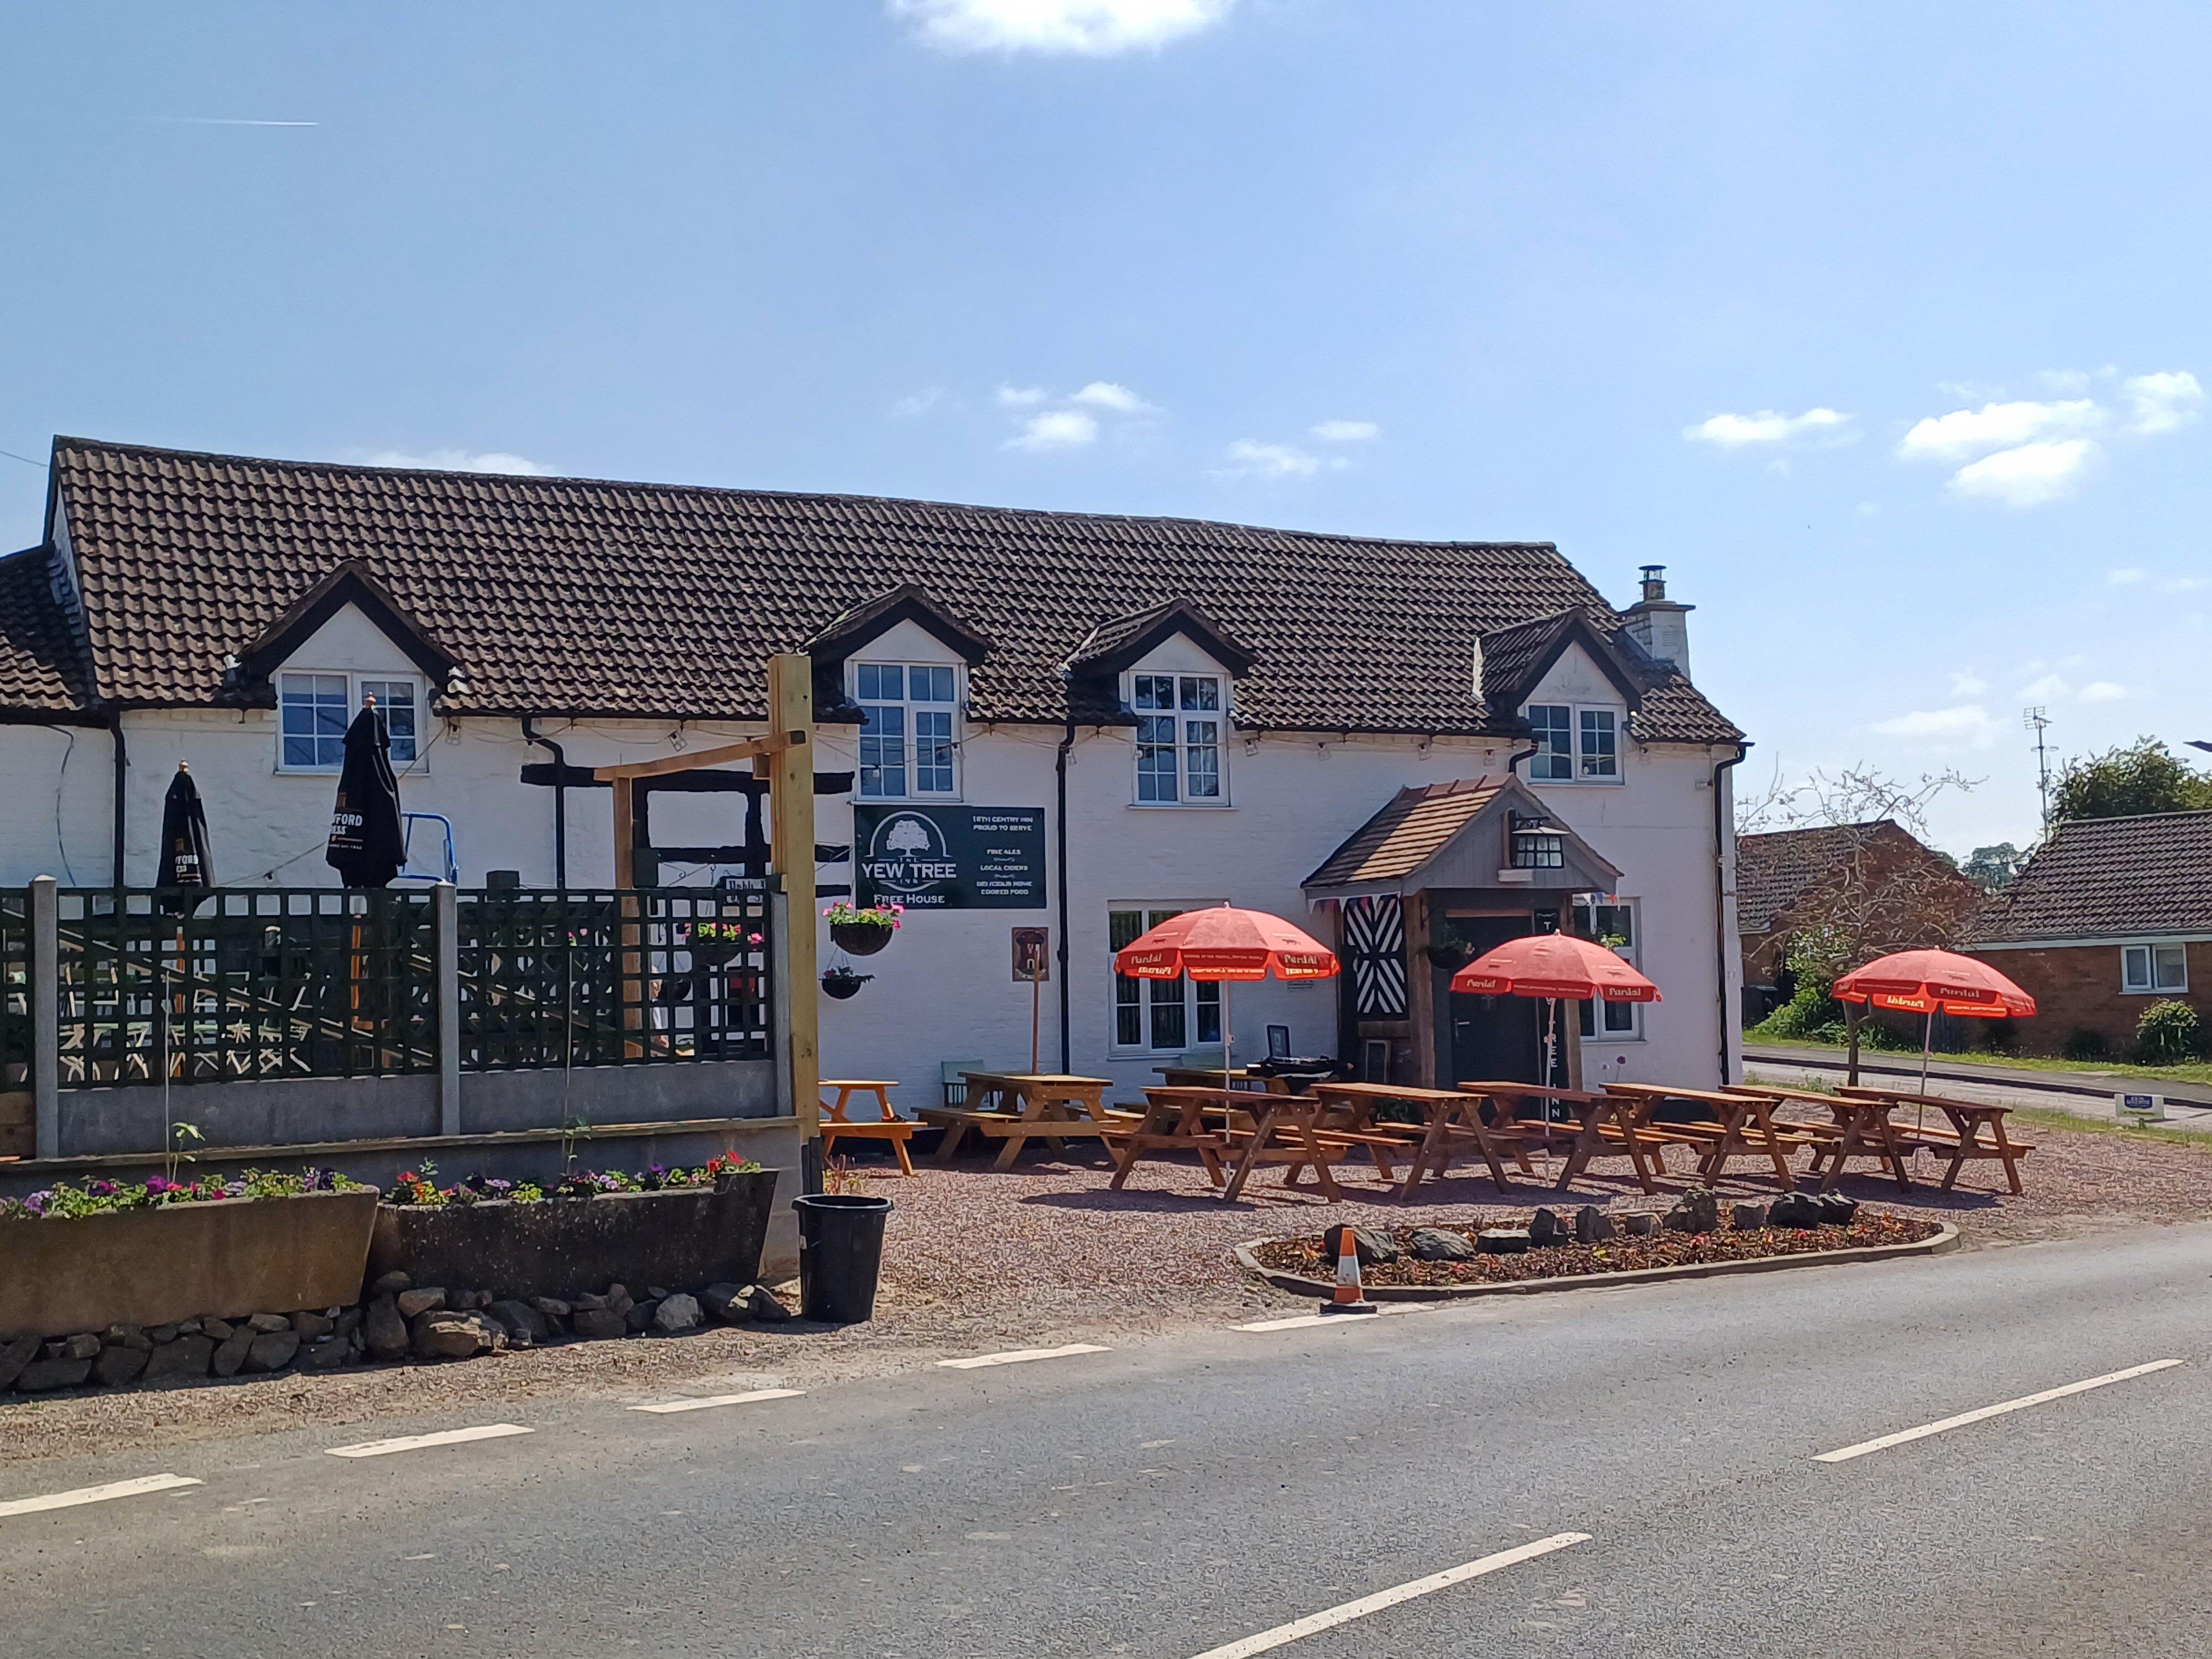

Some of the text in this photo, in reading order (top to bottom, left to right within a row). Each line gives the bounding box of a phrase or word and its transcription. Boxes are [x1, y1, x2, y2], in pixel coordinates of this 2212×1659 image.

[862, 863, 957, 878] YEW TREE
[874, 893, 945, 904] FREE HOUSE
